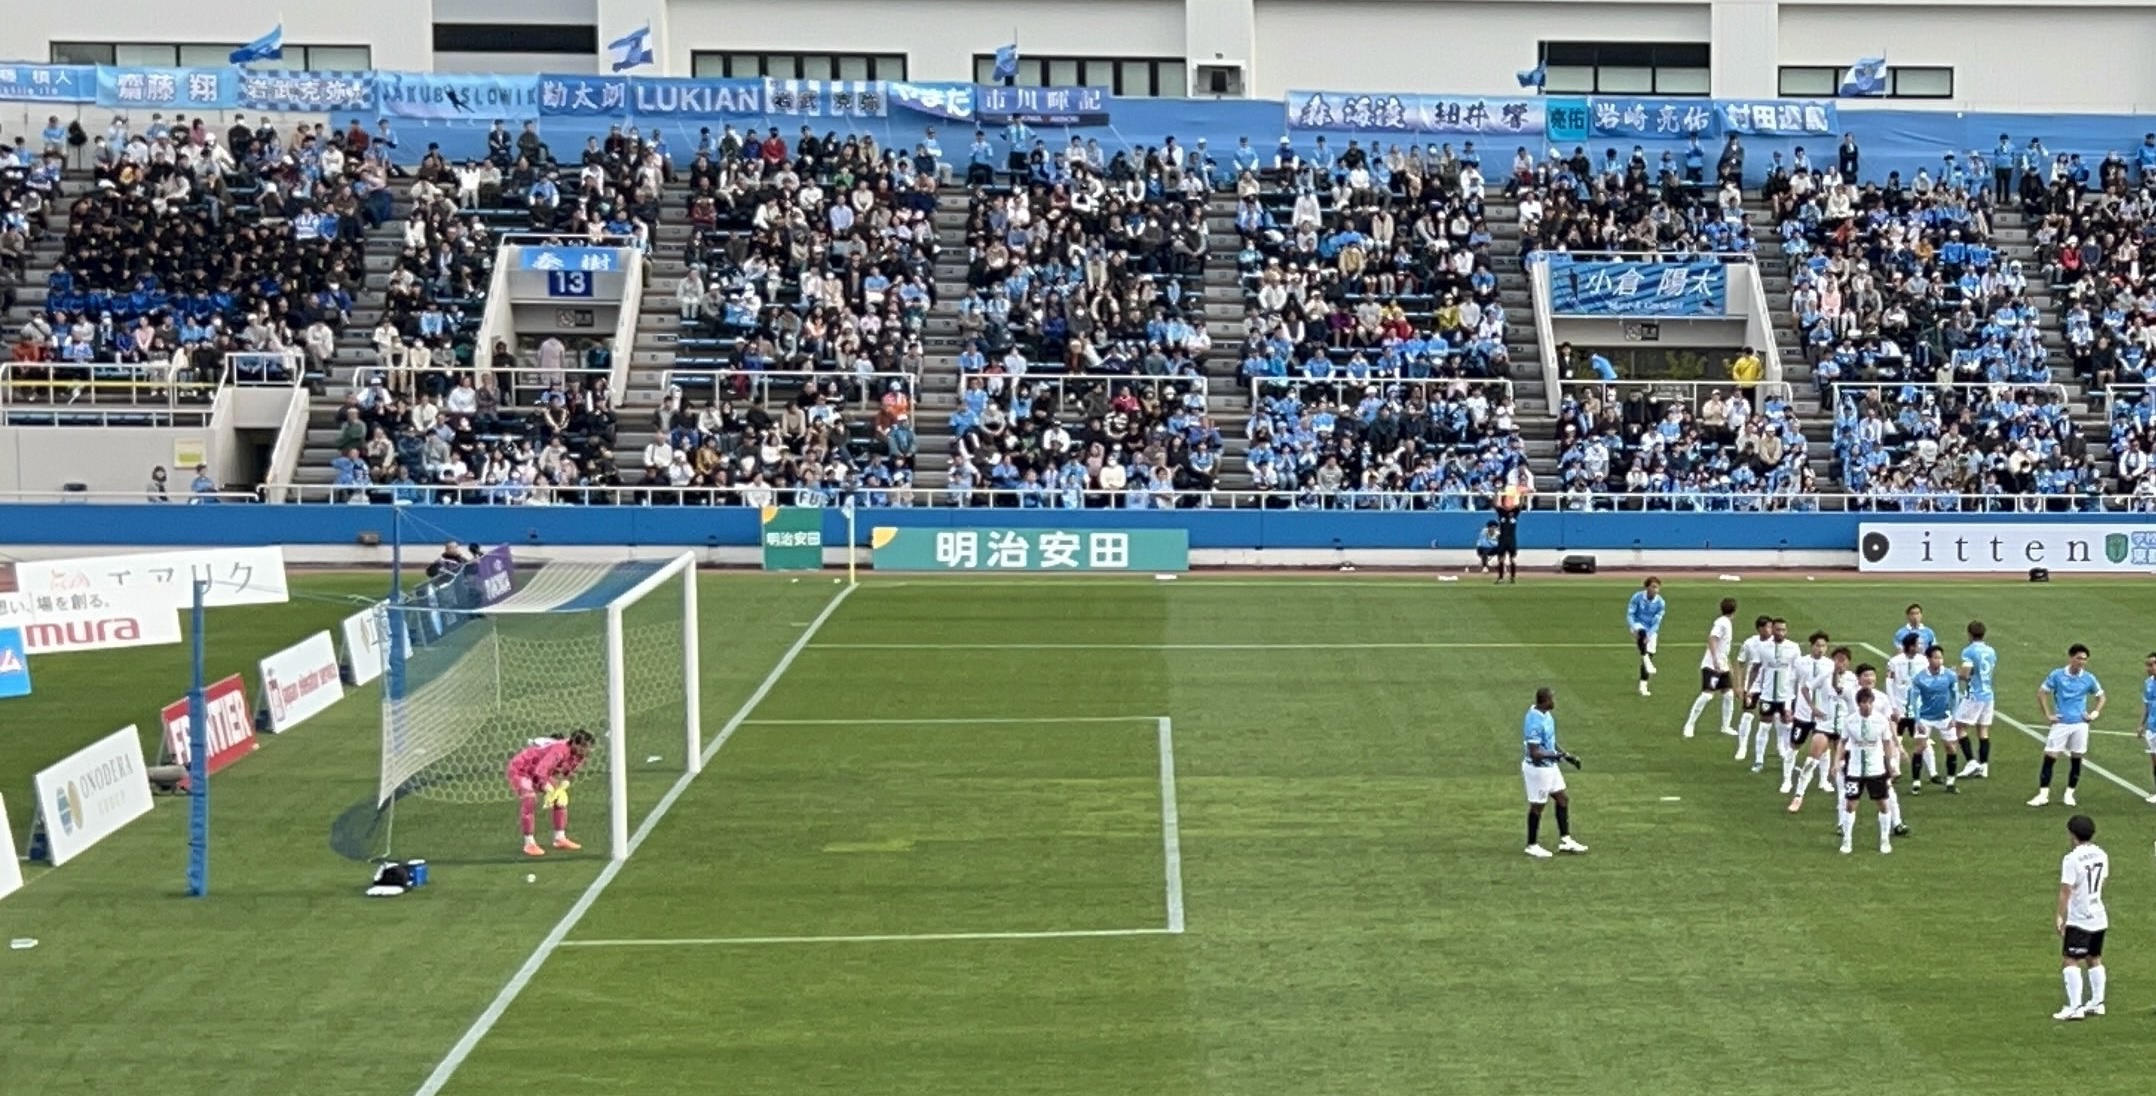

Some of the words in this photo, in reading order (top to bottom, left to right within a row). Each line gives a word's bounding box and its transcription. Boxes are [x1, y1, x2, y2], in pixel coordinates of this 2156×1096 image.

[637, 85, 760, 112] LUKIAN
[556, 271, 586, 294] 13
[766, 531, 821, 547] 明治安田
[936, 530, 1130, 568] 明治安田
[1921, 531, 2092, 563] itten
[25, 617, 141, 648] mura
[167, 689, 253, 766] FRNTIER
[79, 753, 135, 799] ONODERA
[2084, 862, 2104, 895] 17
